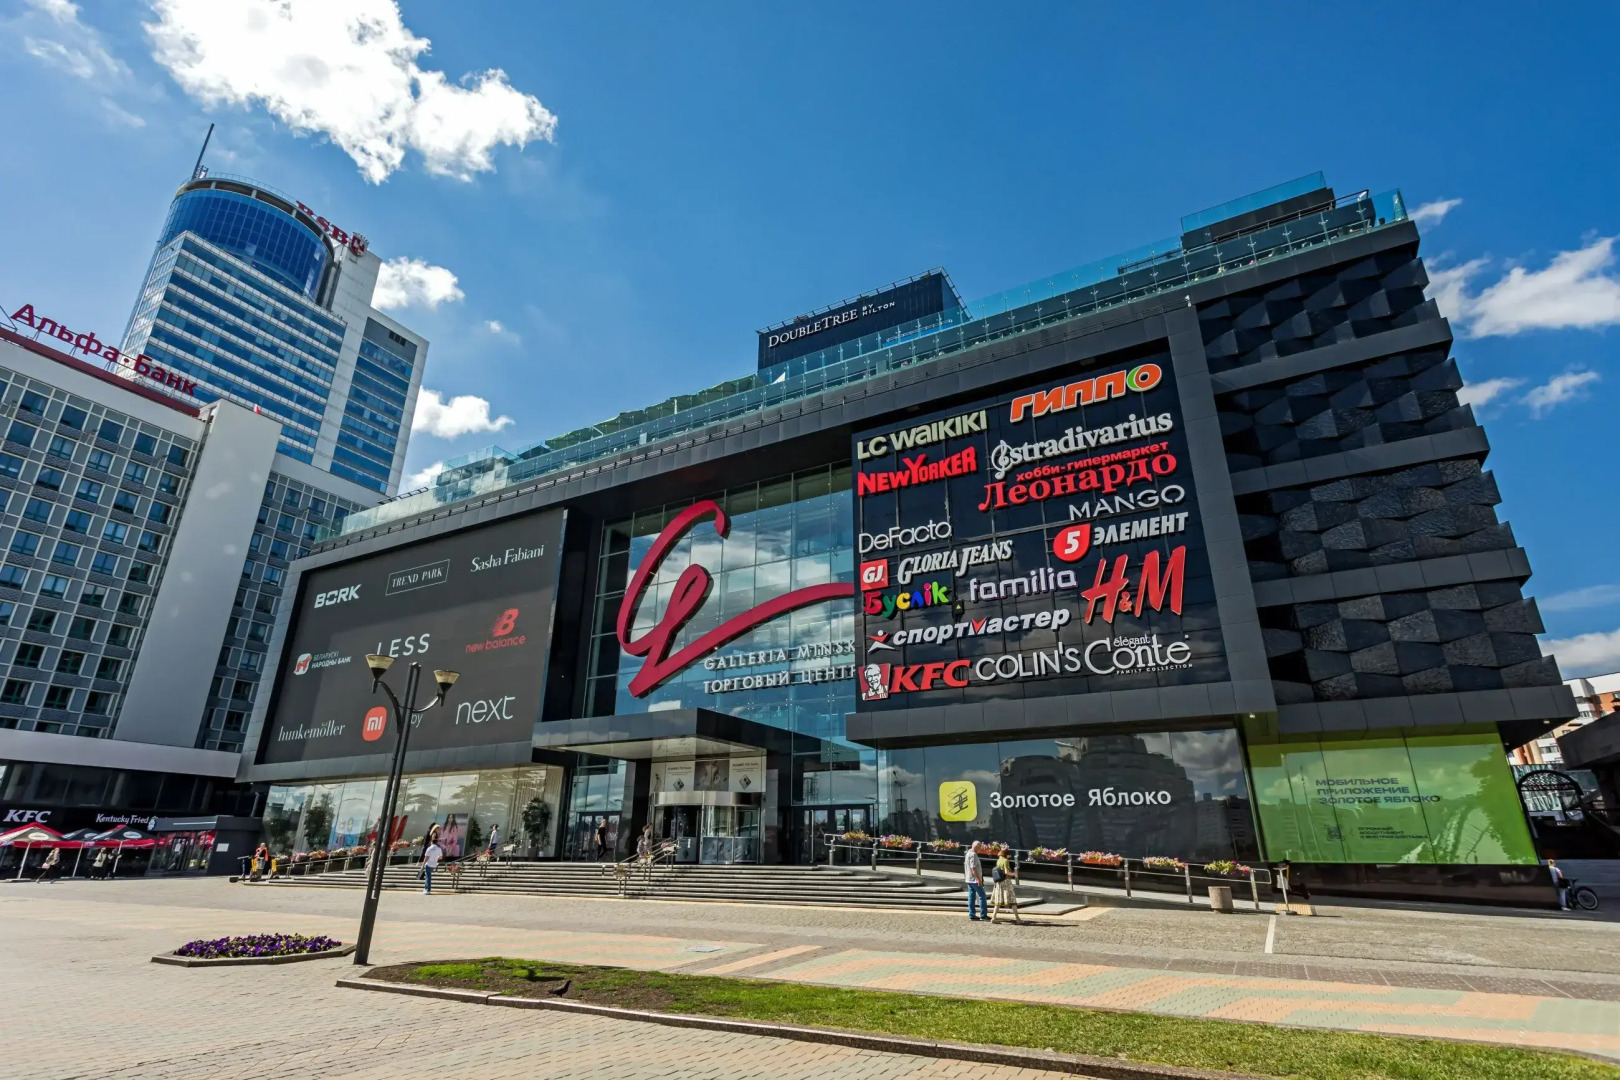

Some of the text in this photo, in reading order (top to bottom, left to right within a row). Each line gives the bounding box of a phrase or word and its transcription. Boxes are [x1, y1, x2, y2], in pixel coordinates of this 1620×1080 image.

[862, 303, 874, 311] BY
[862, 301, 895, 317] HILTON
[768, 309, 859, 348] DOUBLETREE
[857, 436, 888, 460] LC
[1016, 441, 1168, 482] хобби-гипермаркет
[978, 453, 1177, 512] Леонардо
[1070, 484, 1186, 521] MANGO
[859, 519, 952, 554] DeFacto
[1064, 512, 1188, 554] 5 ЭЛЕМЕНТ
[470, 544, 545, 573] Sasha Fabiani
[392, 567, 443, 588] TREND PARK
[970, 567, 1078, 602] familia
[1080, 545, 1187, 625] H&M
[313, 584, 362, 609] BORK
[703, 648, 788, 670] GALLERIA
[975, 634, 1192, 682] COLIN'S Conte
[1146, 663, 1193, 672] COLLECTION
[703, 670, 791, 694] ТОРГОВЫЙ
[889, 659, 972, 694] KFC
[455, 695, 516, 725] next
[1316, 777, 1399, 786] МОБИЛЬНОЕ
[1317, 787, 1410, 795] ПРИЛОЖЕНИЕ
[989, 786, 1172, 809] Золотое Яблоко
[1320, 794, 1441, 804] ЗОЛОТОЕ ЯБЛОКО
[3, 809, 52, 823] KFC
[95, 813, 130, 825] Kentucky
[130, 814, 150, 824] Fried
